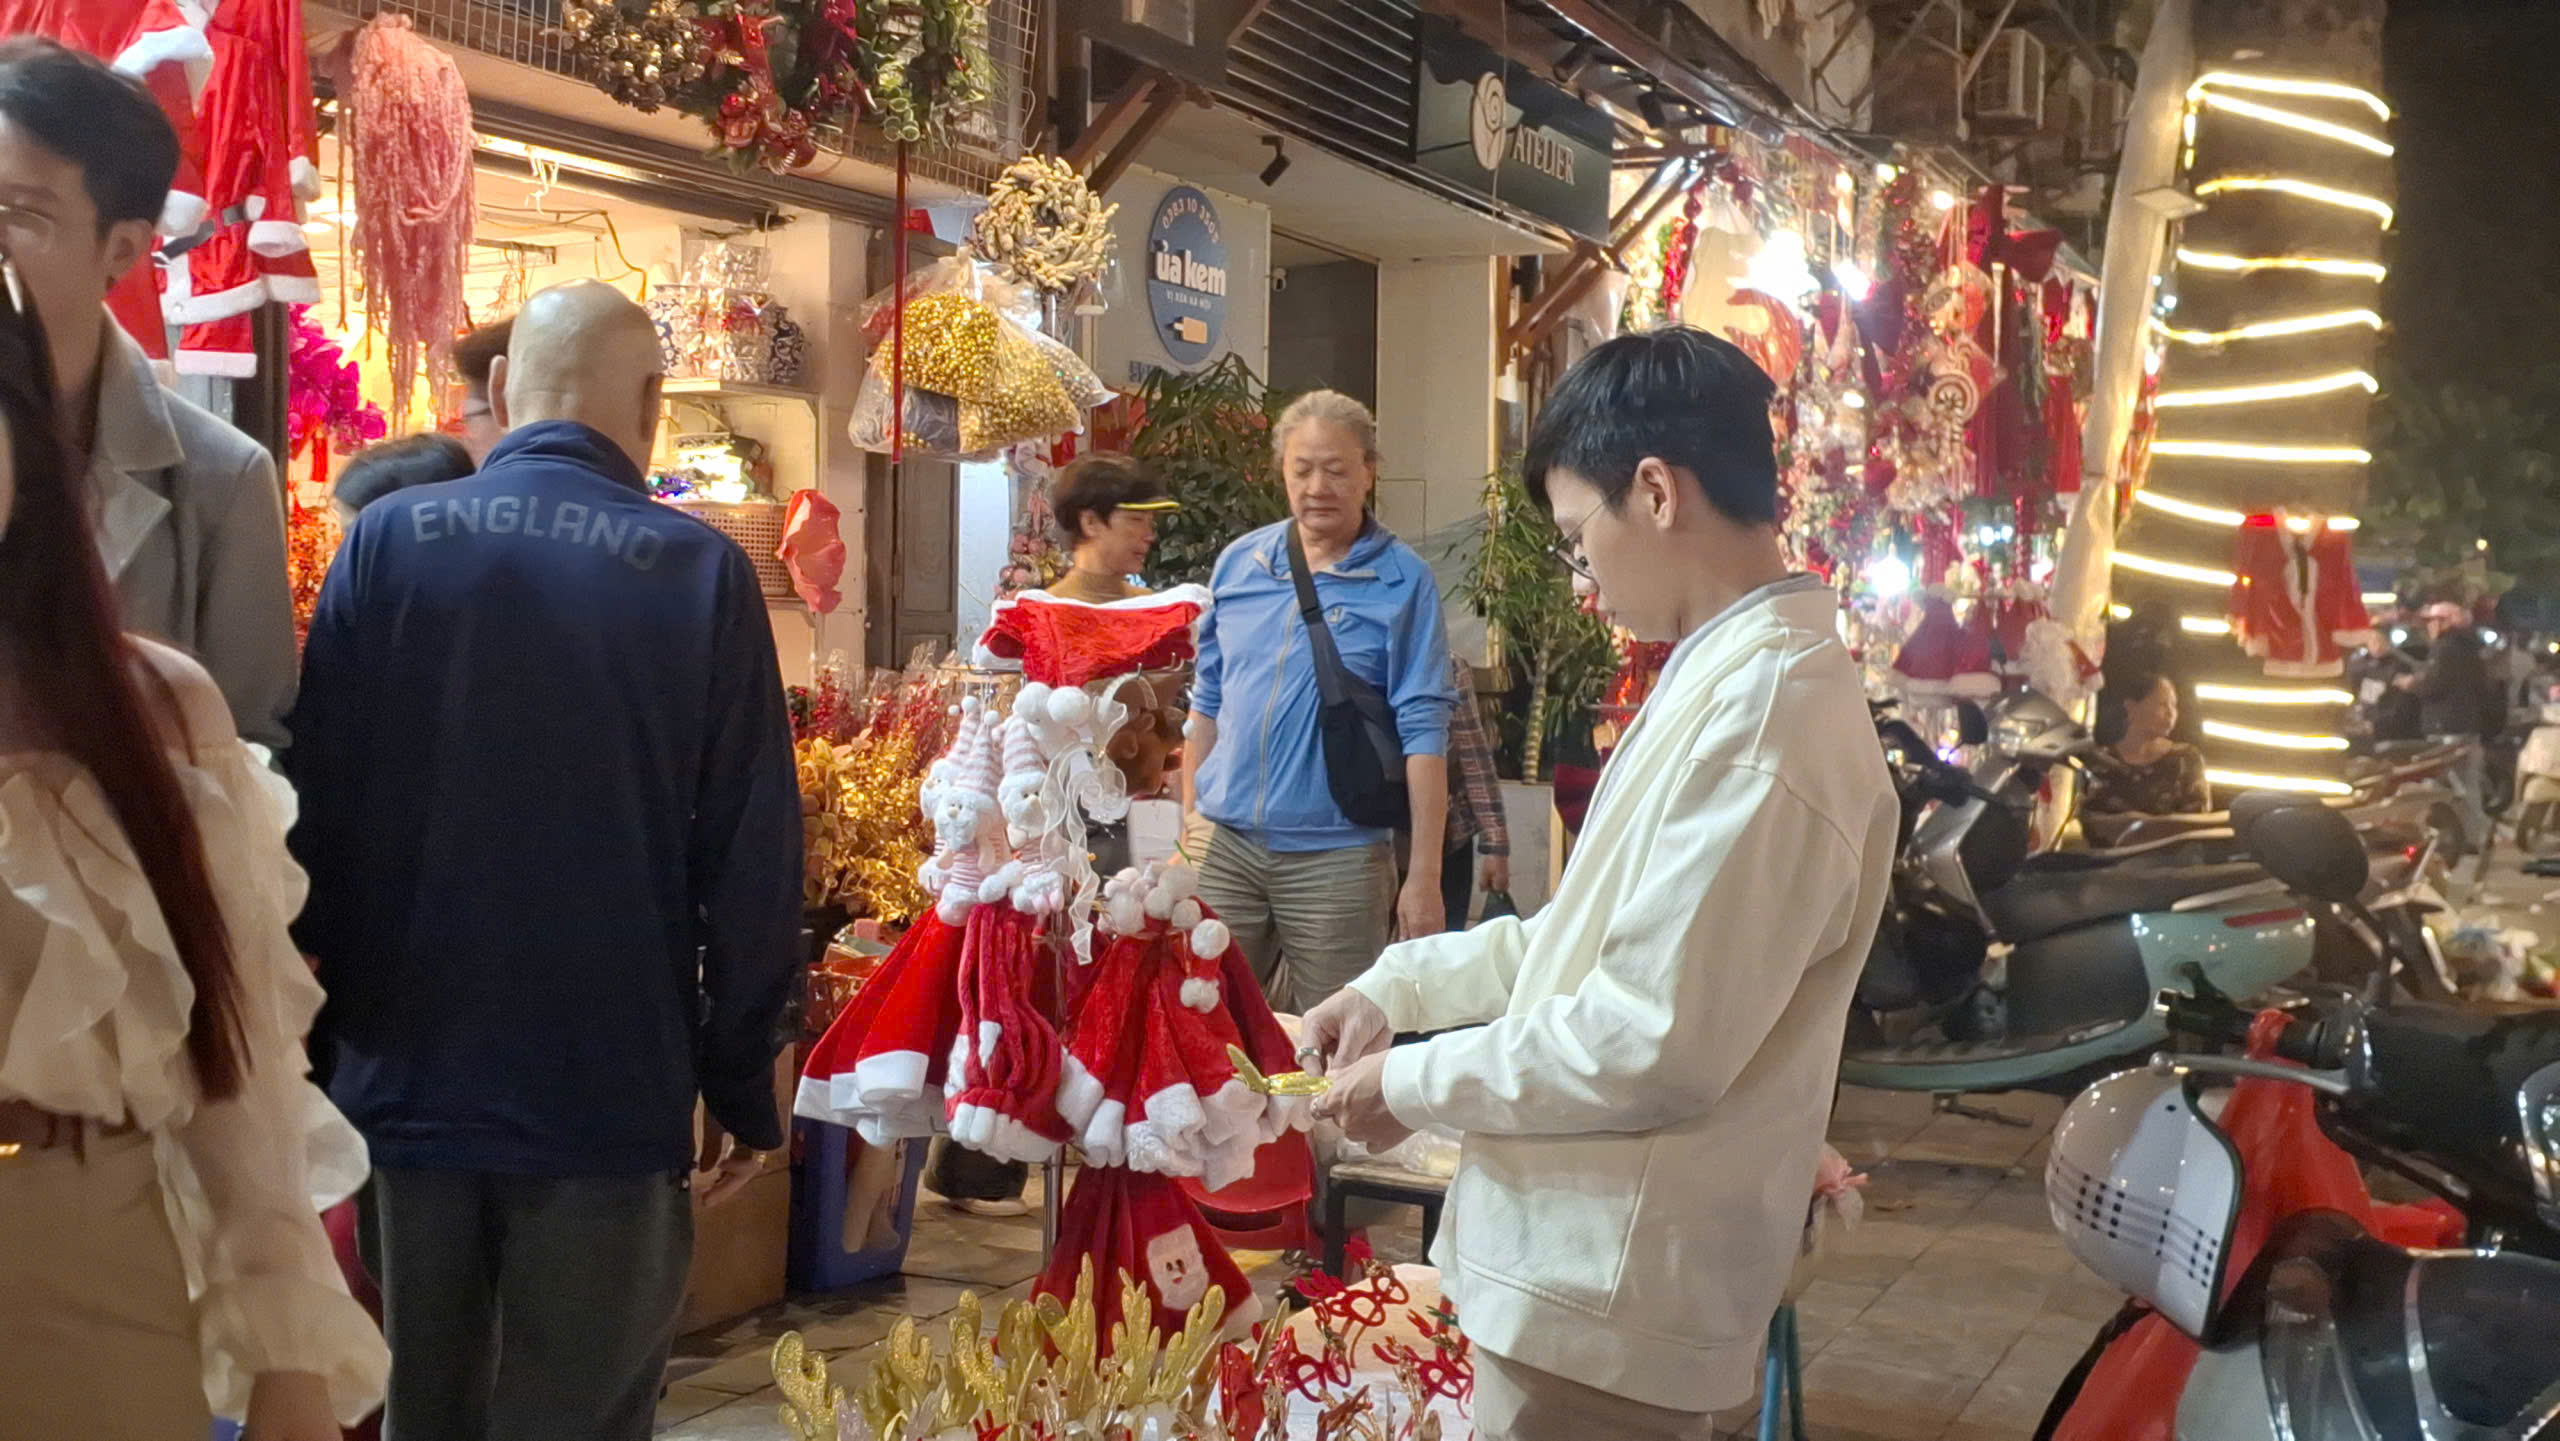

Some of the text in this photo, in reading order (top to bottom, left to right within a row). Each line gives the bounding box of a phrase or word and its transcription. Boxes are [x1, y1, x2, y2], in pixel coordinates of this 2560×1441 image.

[1511, 124, 1575, 186] ATELIER
[1187, 197, 1198, 213] 10
[1184, 248, 1226, 296] kem
[411, 496, 664, 570] ENGLAND
